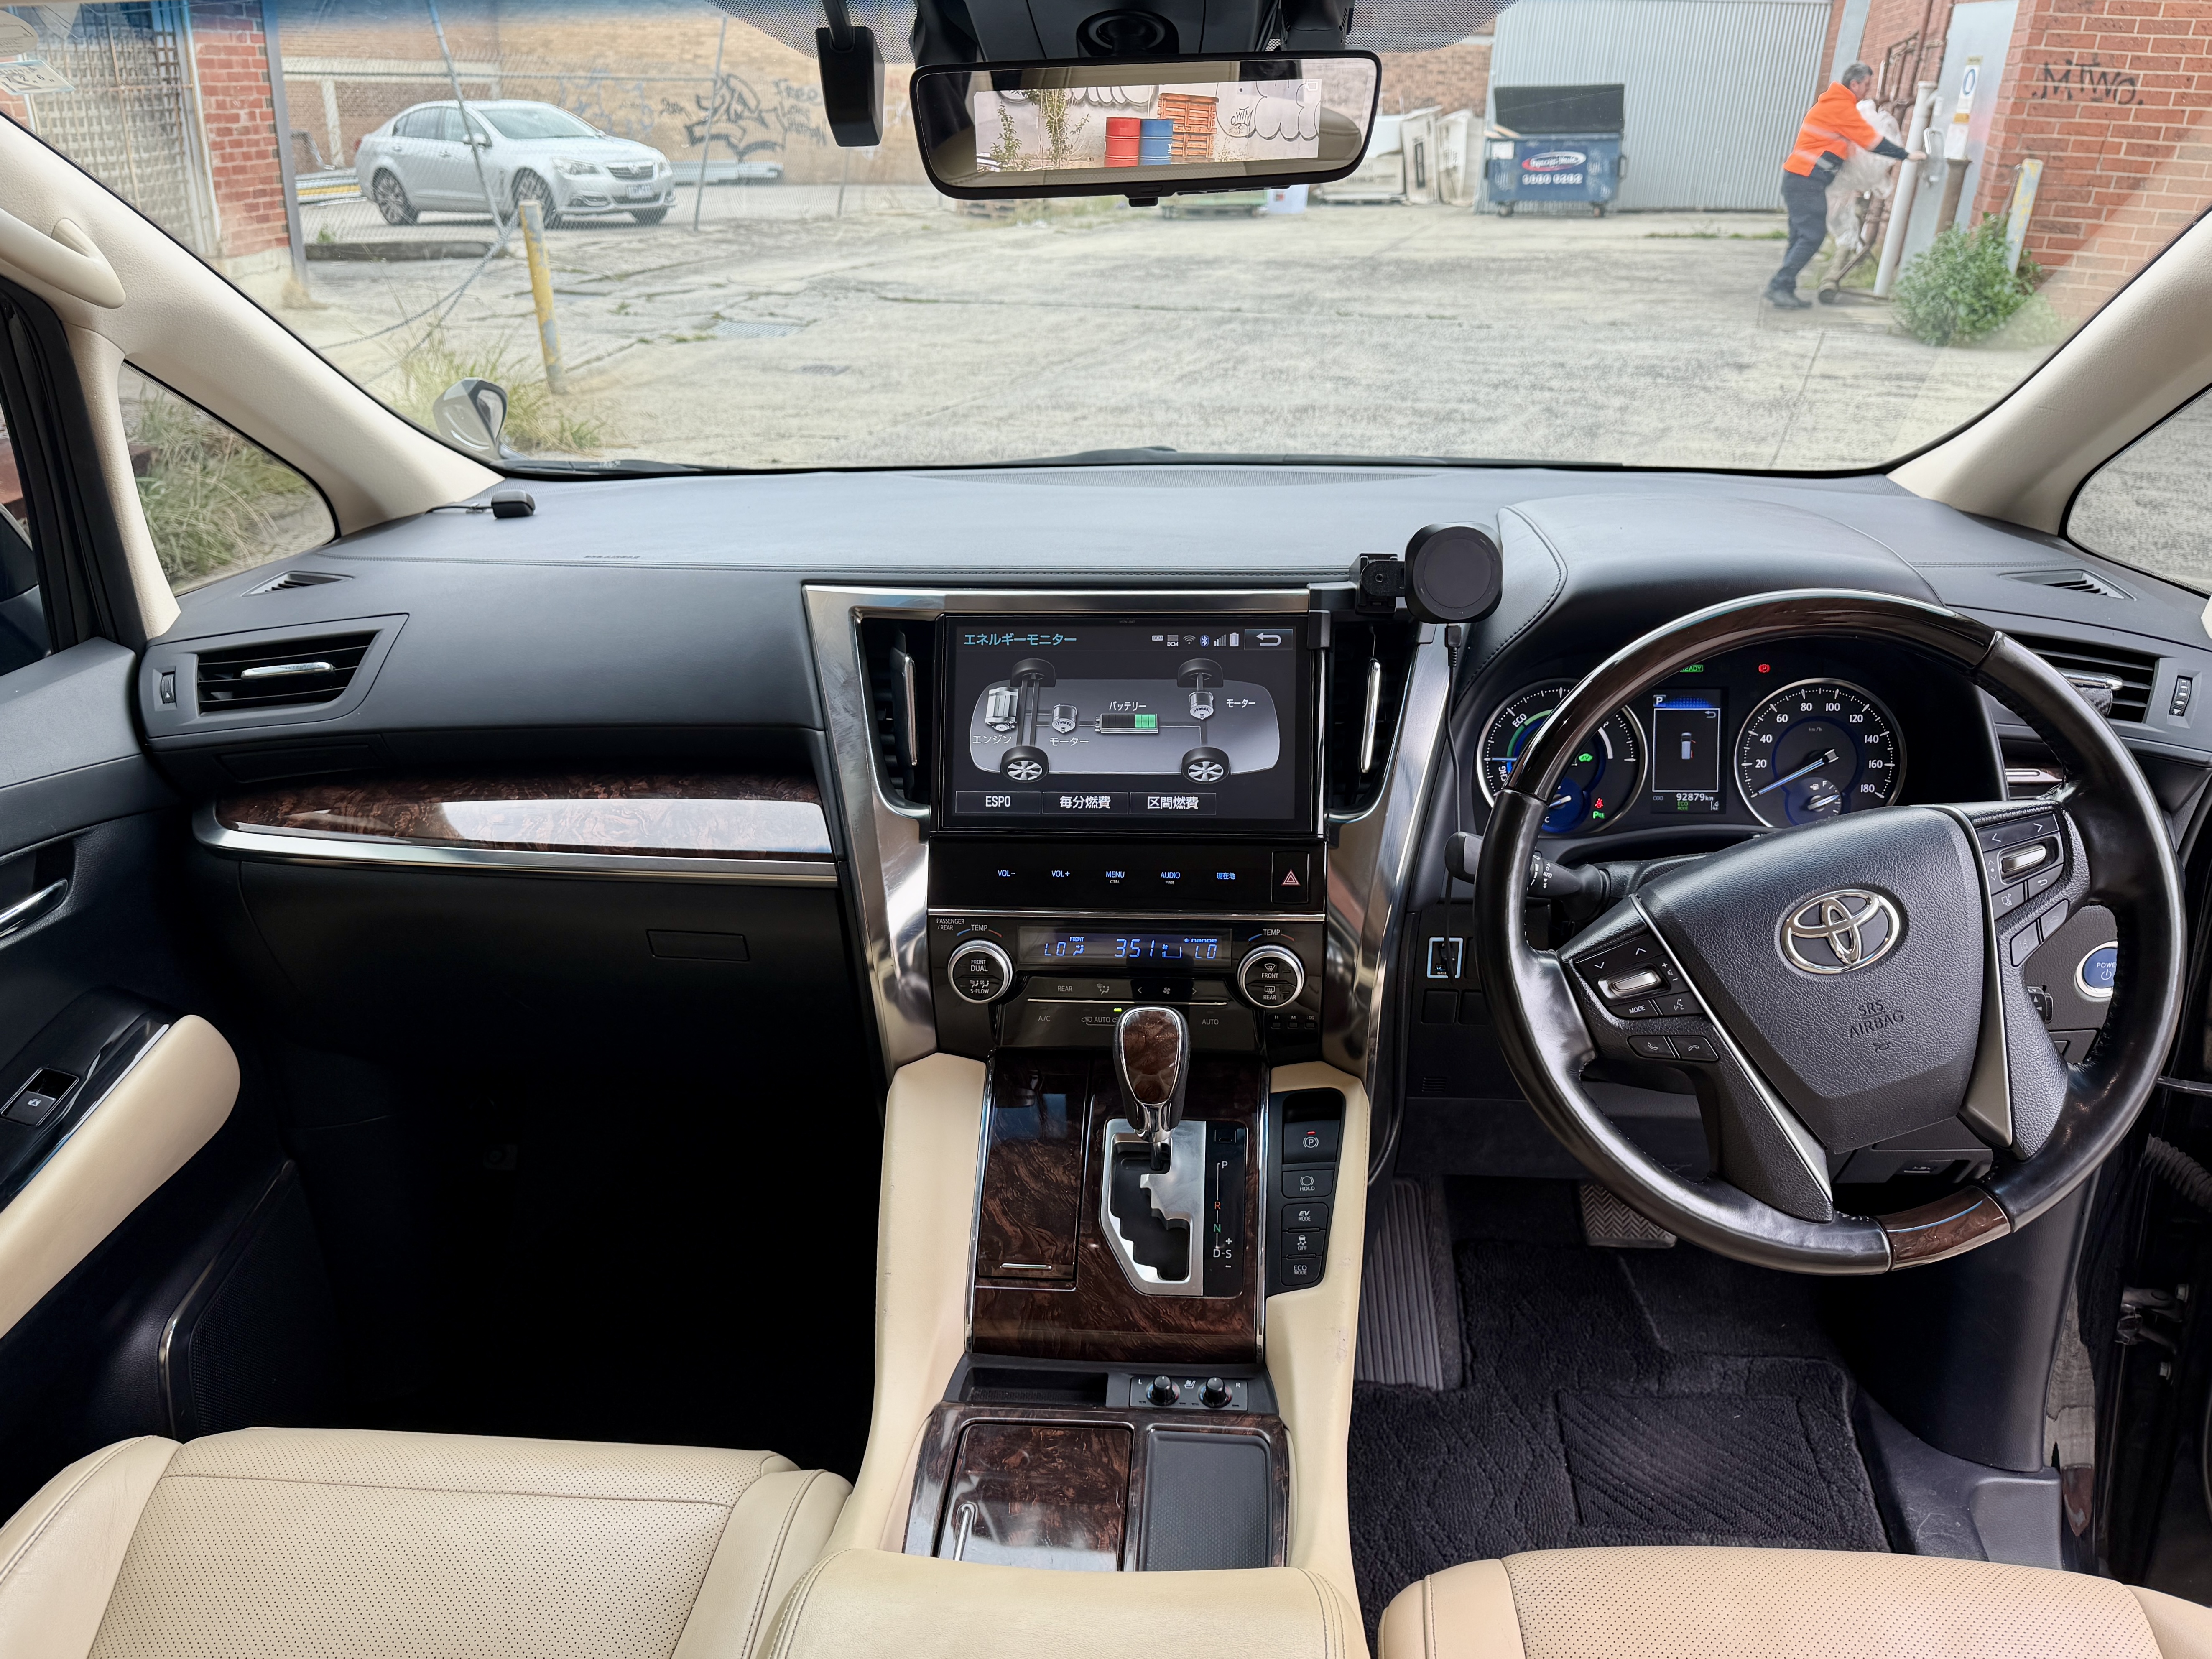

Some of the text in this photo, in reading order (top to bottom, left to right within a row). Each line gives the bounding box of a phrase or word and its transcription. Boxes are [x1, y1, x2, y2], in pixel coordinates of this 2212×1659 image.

[964, 633, 1077, 645] エネルギーモニター
[1226, 699, 1256, 707] モーター
[1656, 697, 1663, 705] P
[1109, 702, 1146, 711] バッテリー
[1801, 703, 1812, 711] 80
[1826, 703, 1840, 711] 100
[1512, 713, 1527, 728] ECO
[1776, 714, 1788, 722] 60
[1850, 715, 1863, 723] 120
[973, 735, 1012, 744] エンジン
[1049, 737, 1089, 746] モーター
[1760, 734, 1773, 743] 40
[1865, 735, 1879, 743] 140
[1755, 759, 1767, 768] 20
[1869, 760, 1883, 768] 160
[1861, 784, 1875, 793] 180
[985, 796, 1010, 807] ESPO
[1060, 796, 1111, 809] 毎分燃費
[1147, 796, 1199, 809] 区間燃費
[1216, 872, 1236, 880] 現在地
[1858, 1000, 1883, 1016] SRS
[1850, 1010, 1904, 1038] AIRBAG
[1214, 1202, 1221, 1210] R
[1213, 1224, 1221, 1233] N
